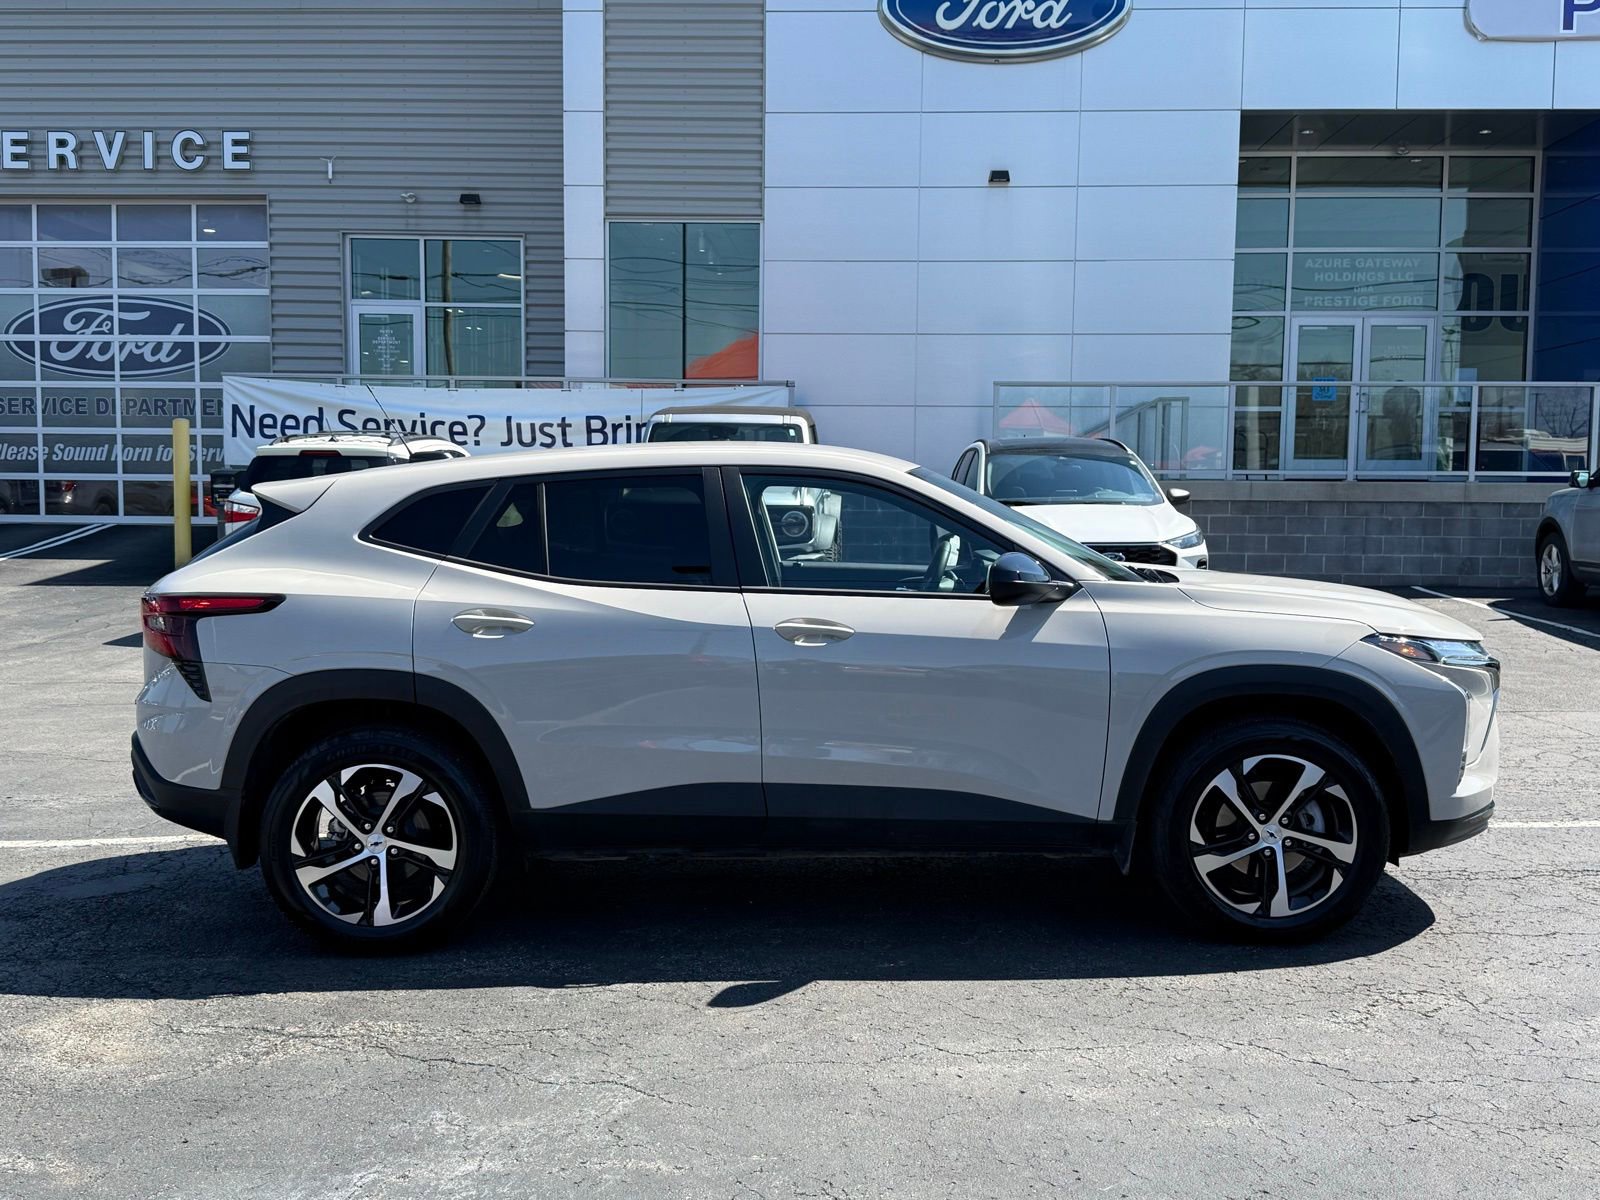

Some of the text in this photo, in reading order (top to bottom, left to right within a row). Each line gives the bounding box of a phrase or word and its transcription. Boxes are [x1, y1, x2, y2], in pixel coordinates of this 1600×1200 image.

[0, 129, 251, 171] ERVICE
[1305, 258, 1420, 268] AZURE GATEWAY
[1314, 271, 1385, 282] HOLDINGS
[1304, 295, 1423, 307] PRESTIGE FORD
[49, 307, 185, 363] Ford
[231, 404, 324, 439] Need
[337, 409, 486, 446] Service?
[500, 415, 574, 449] Just
[0, 443, 49, 461] lease
[52, 443, 109, 461] Sound
